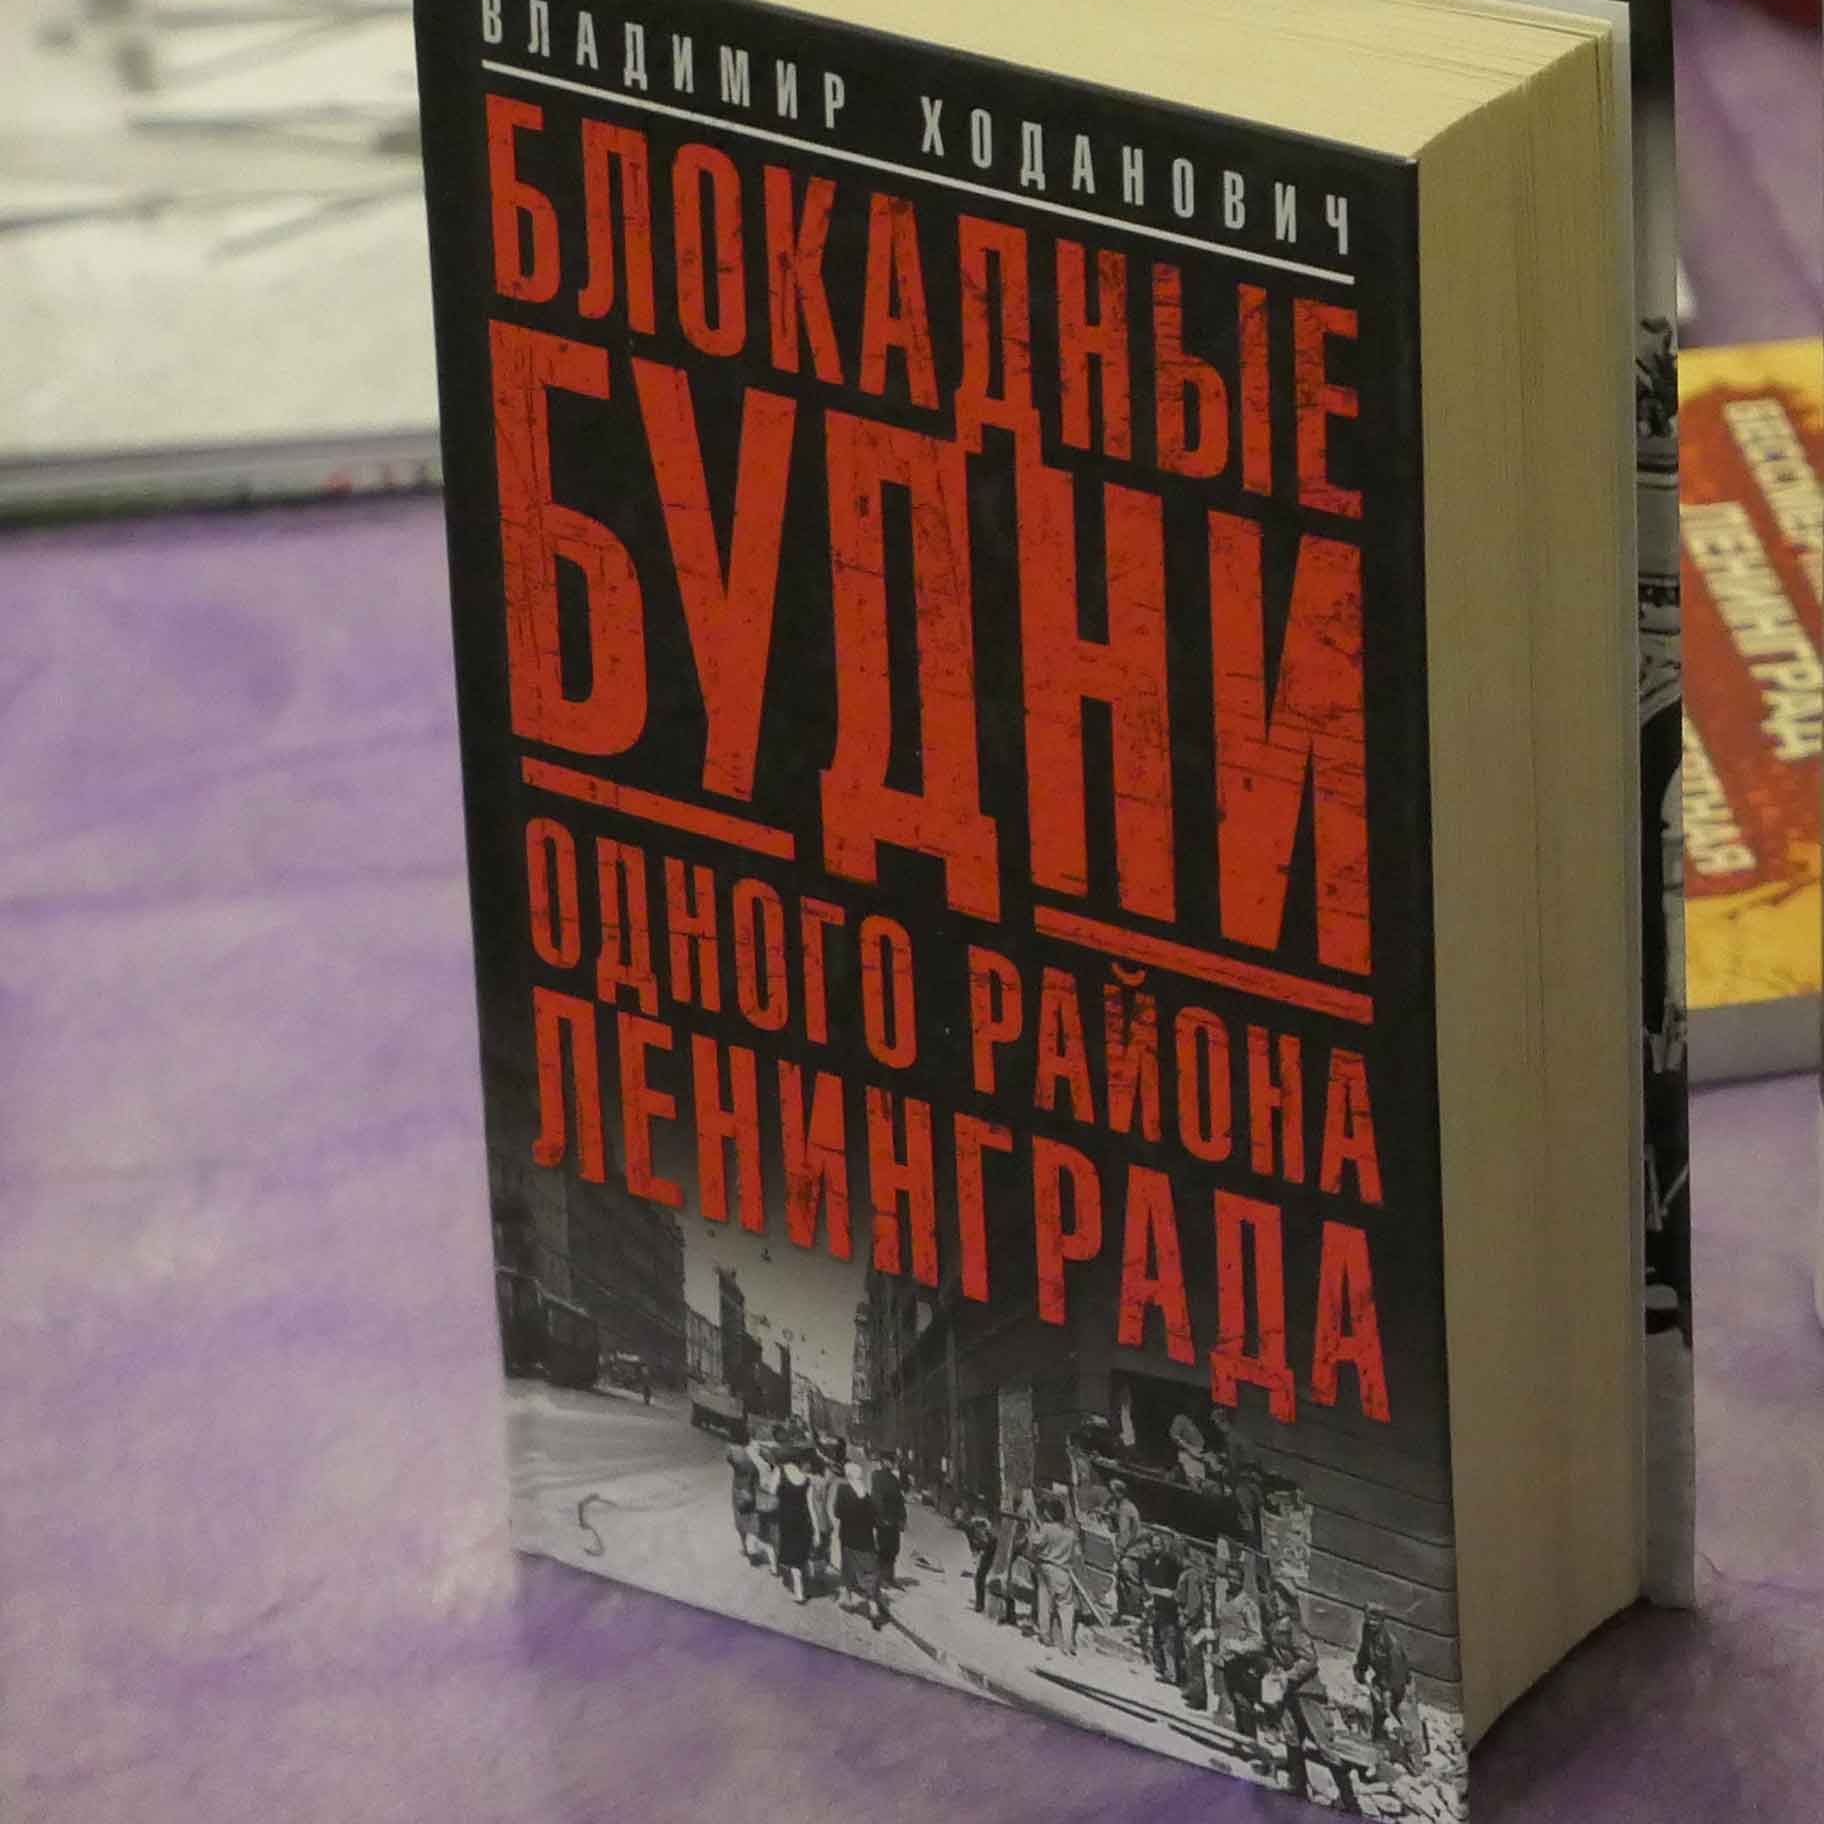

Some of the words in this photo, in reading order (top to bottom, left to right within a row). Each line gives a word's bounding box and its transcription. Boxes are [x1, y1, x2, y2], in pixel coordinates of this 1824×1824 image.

[484, 92, 1363, 519] БЛОКАДНЫЕ
[921, 96, 1351, 256] ХОДАНОВИЧ
[488, 319, 1372, 975] БУДНИ
[524, 818, 916, 1071] ОДНОГО
[969, 944, 1383, 1207] РАЙОНА
[532, 985, 1390, 1422] ЛЕНИНГРАДА
